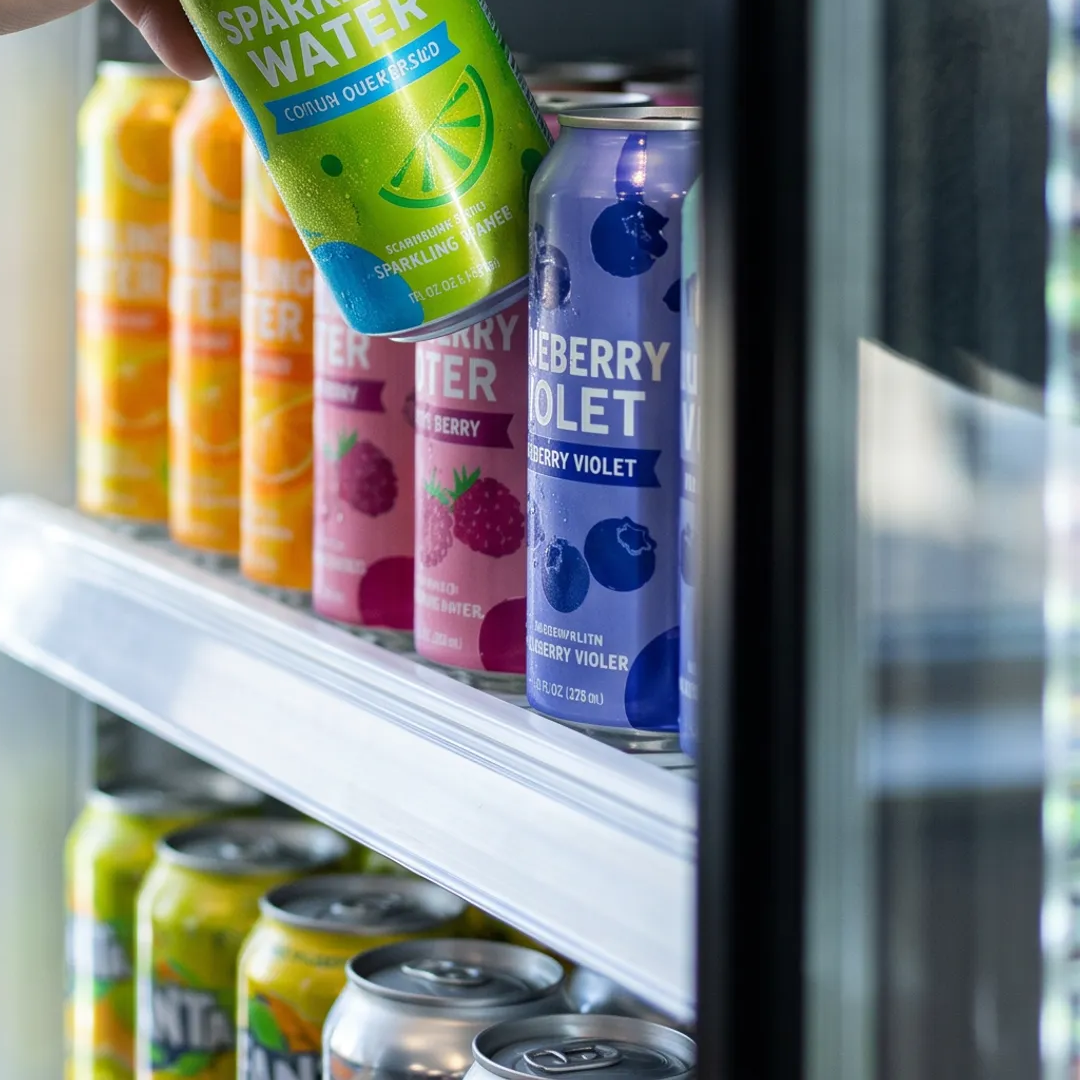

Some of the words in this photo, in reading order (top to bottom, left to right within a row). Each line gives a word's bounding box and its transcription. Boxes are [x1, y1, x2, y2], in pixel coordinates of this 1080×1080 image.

[373, 236, 459, 280] SPARKLING
[434, 415, 480, 438] BERRY
[573, 453, 637, 478] VIOLET
[575, 648, 629, 672] VIOLER
